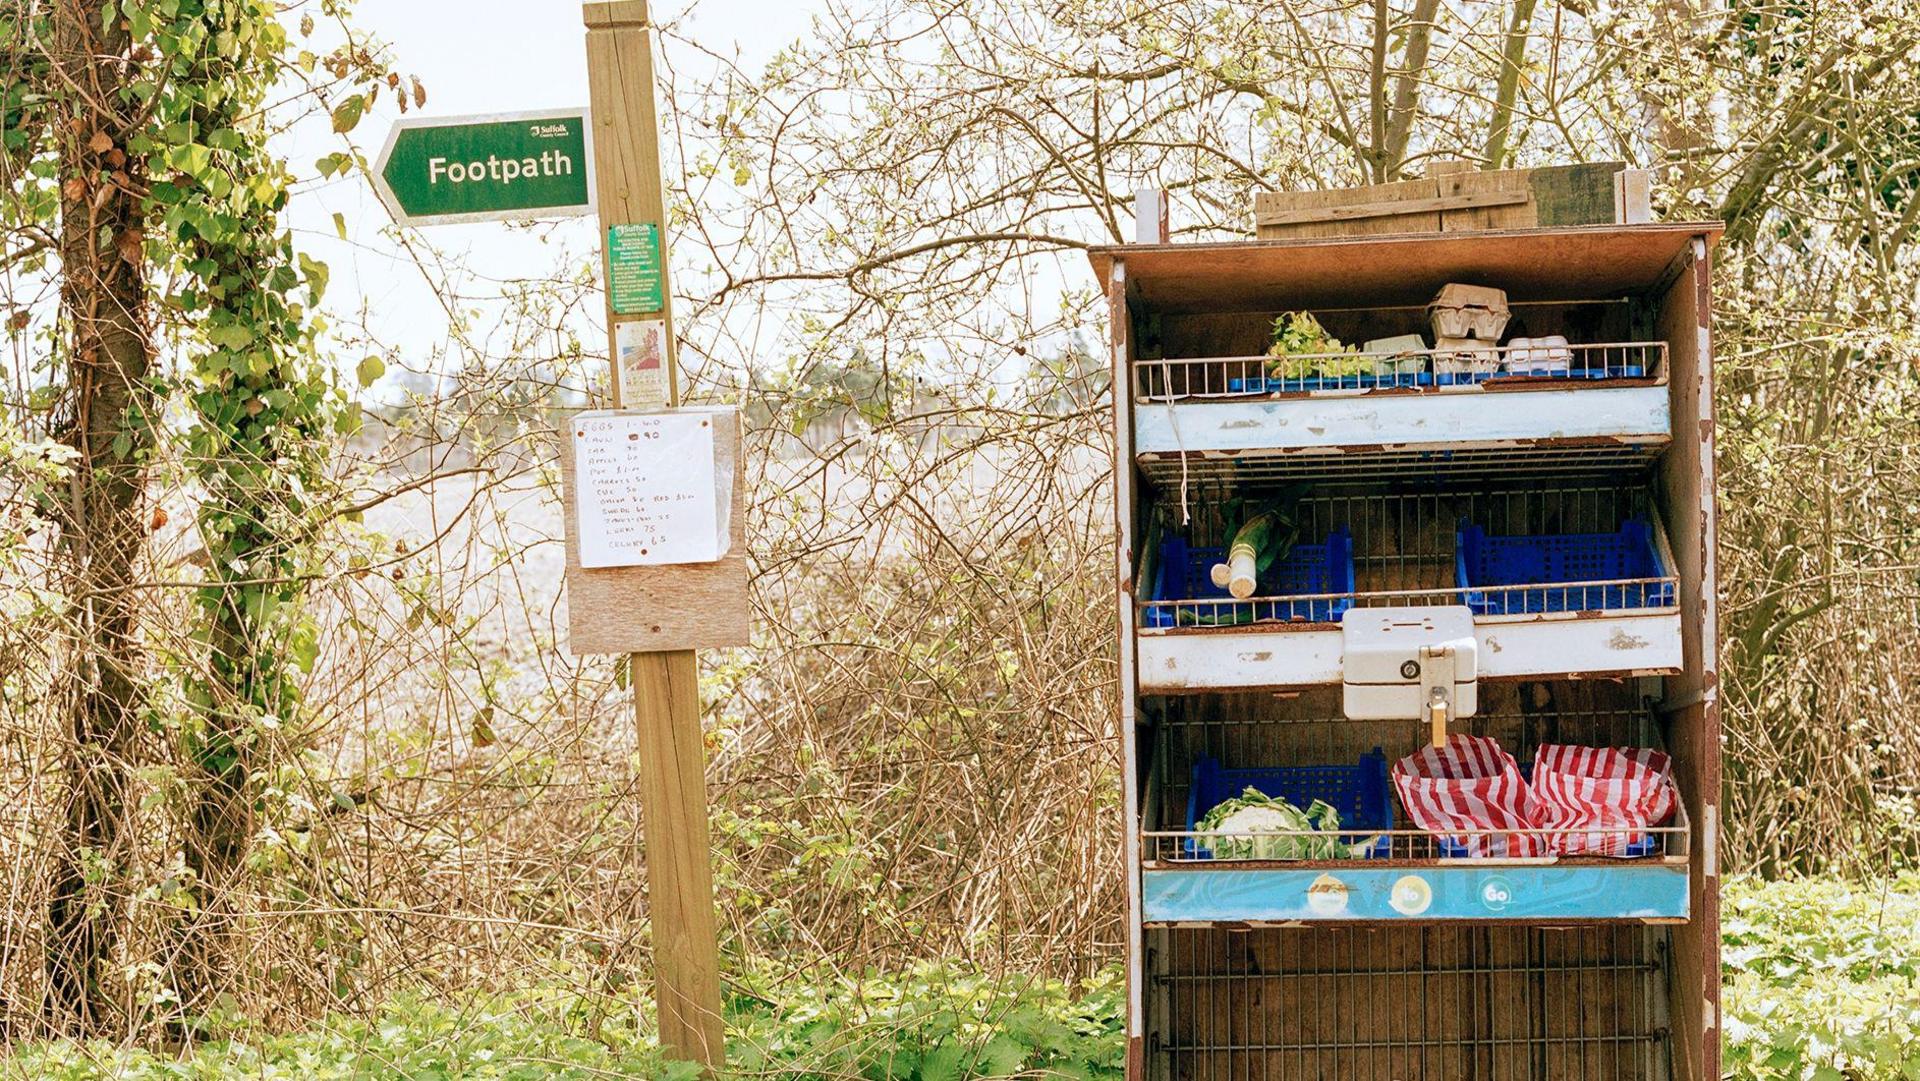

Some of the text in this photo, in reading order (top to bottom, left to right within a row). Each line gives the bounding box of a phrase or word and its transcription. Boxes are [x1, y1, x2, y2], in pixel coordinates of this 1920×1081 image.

[429, 150, 572, 184] Footpath
[582, 421, 614, 432] EGGS
[644, 431, 660, 440] 90
[1483, 884, 1508, 902] Go
